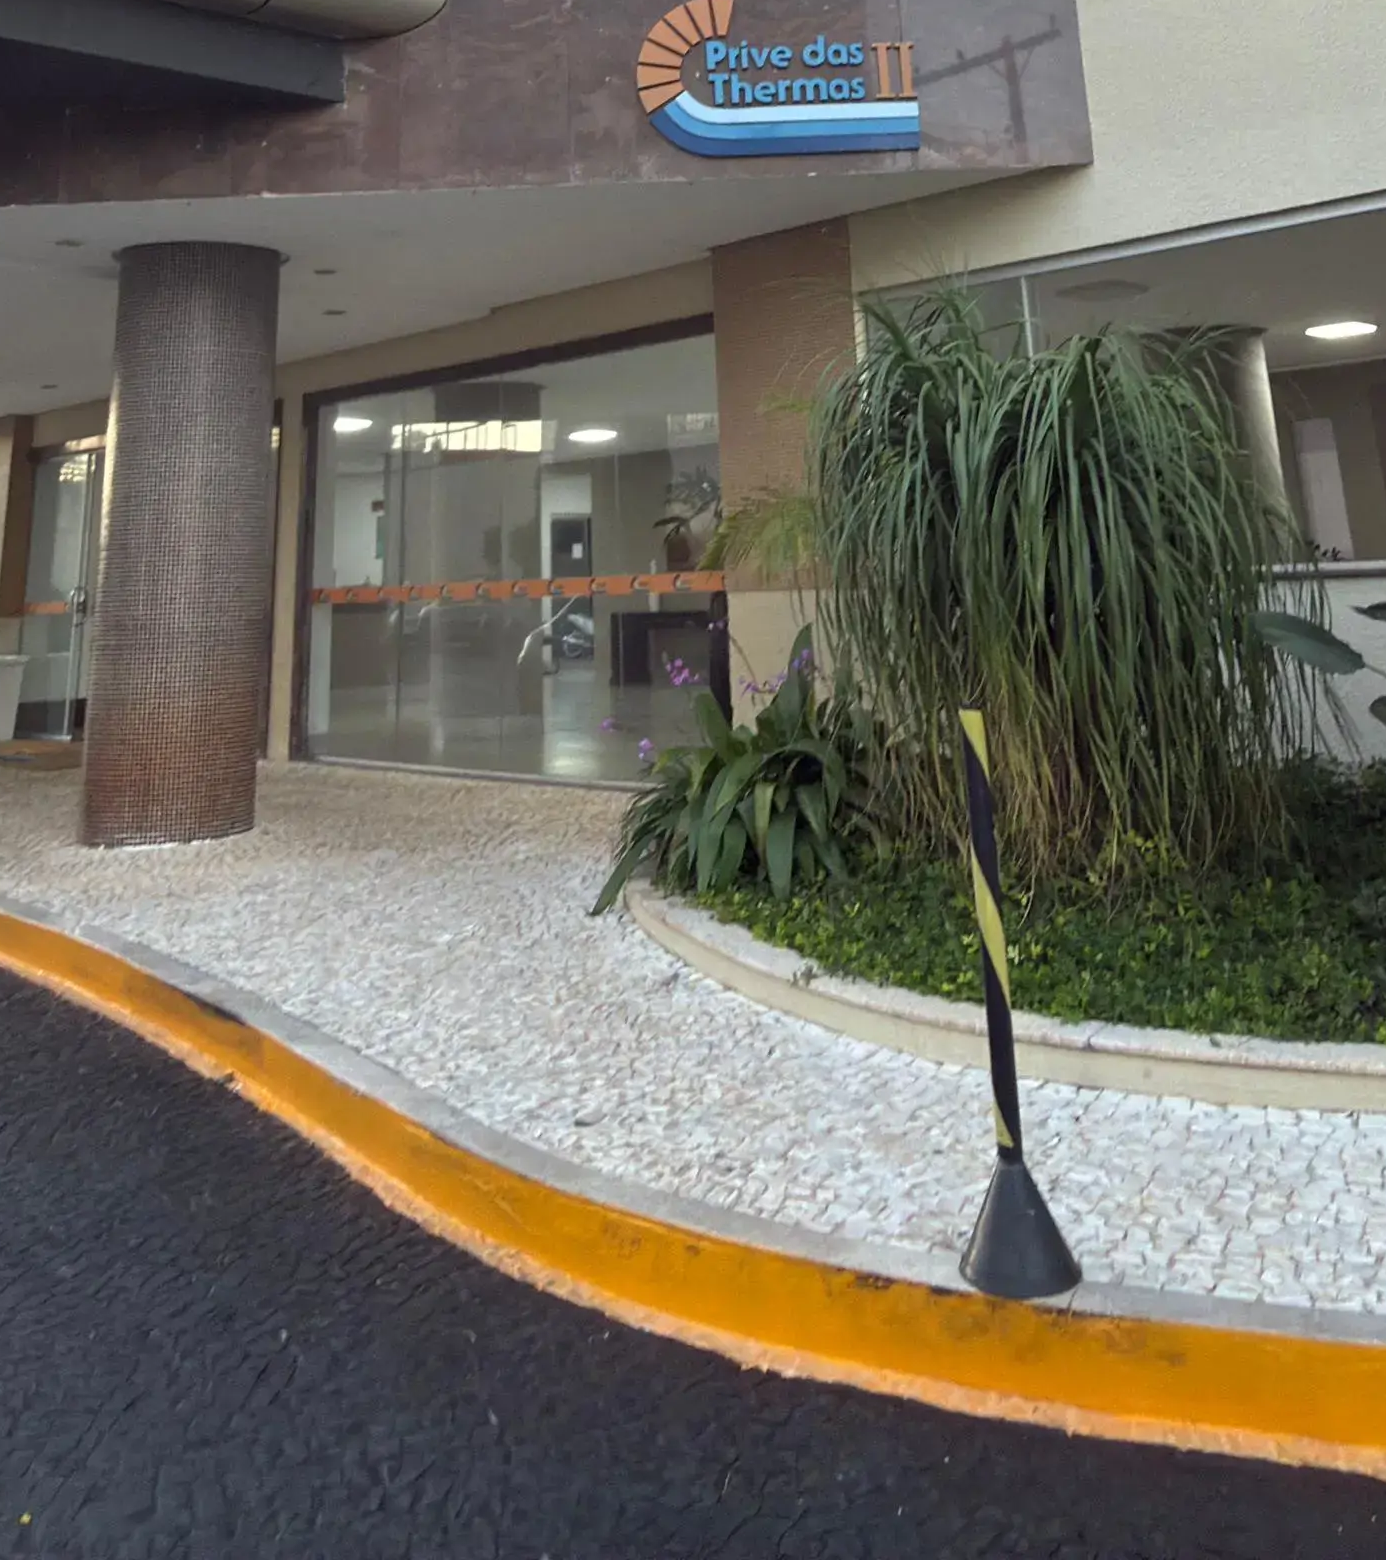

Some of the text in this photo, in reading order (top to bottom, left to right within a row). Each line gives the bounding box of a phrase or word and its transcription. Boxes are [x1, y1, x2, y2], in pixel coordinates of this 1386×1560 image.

[705, 34, 865, 71] Prive das
[708, 42, 918, 106] Thermas II
